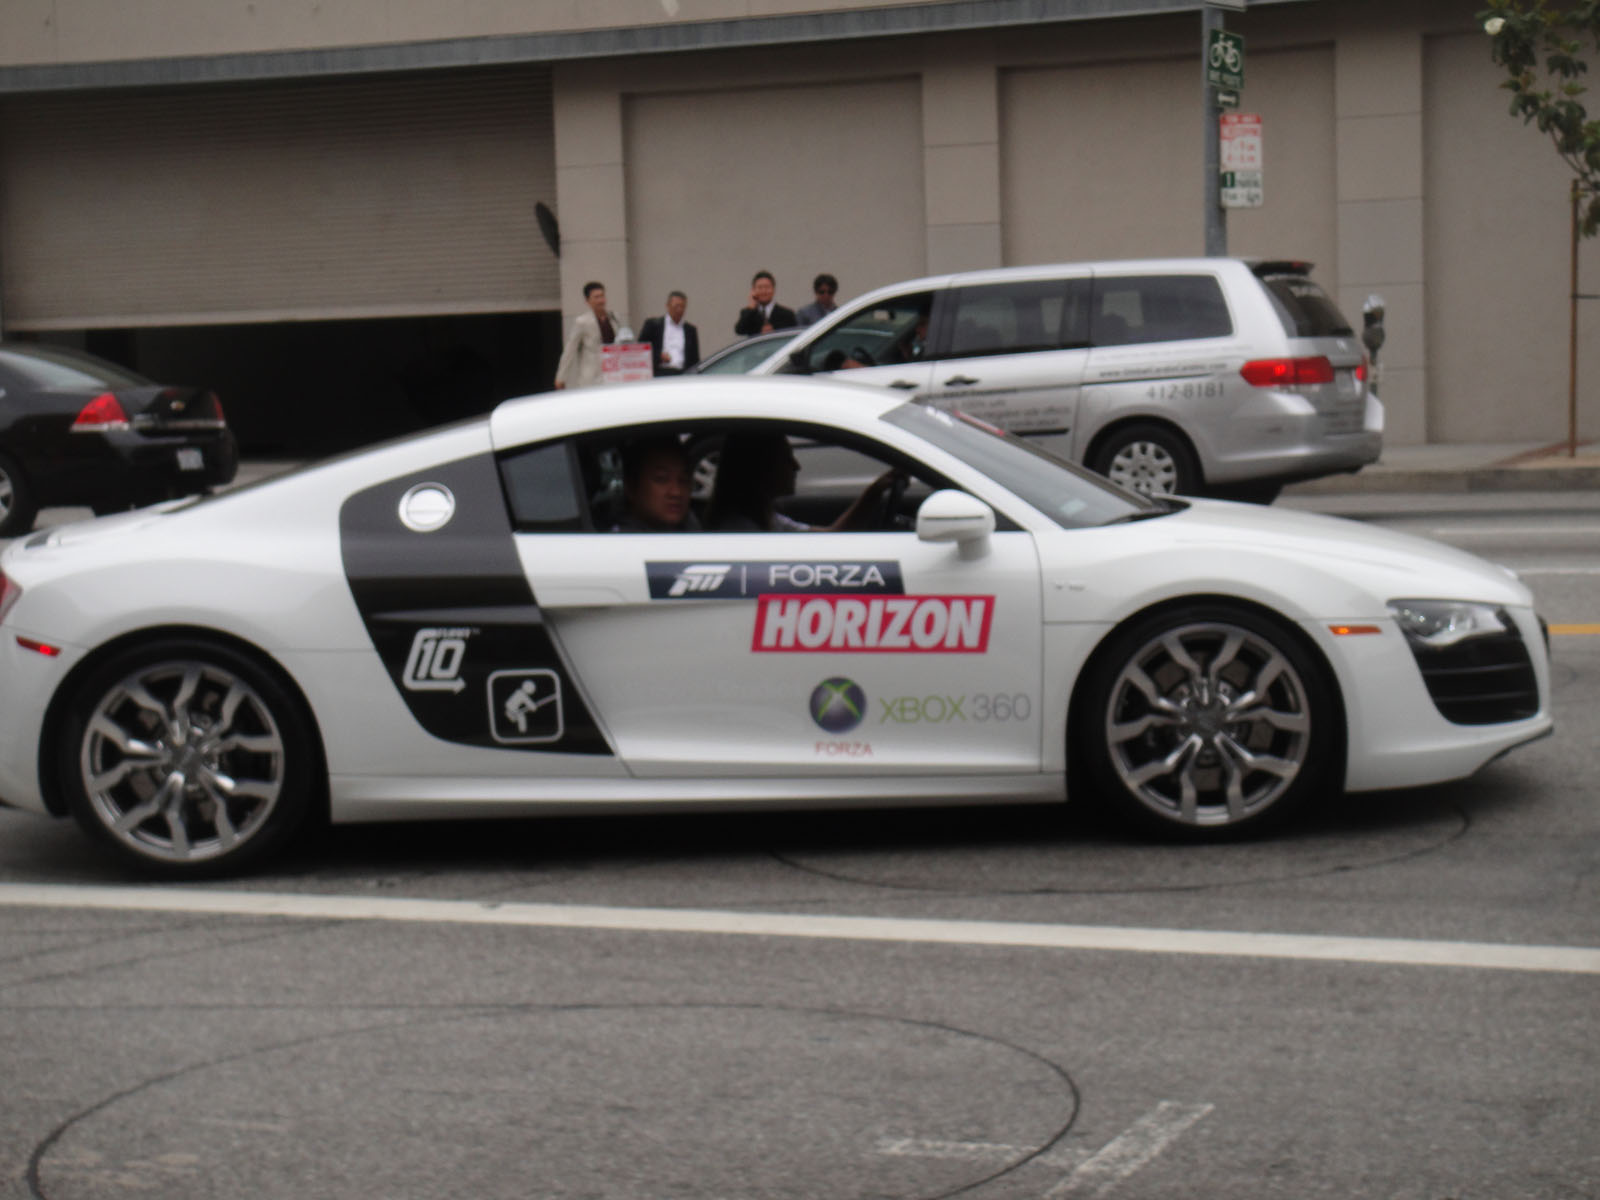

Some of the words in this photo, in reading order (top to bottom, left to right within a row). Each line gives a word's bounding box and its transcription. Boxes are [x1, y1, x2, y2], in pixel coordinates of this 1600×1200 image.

[1146, 382, 1224, 399] 412-8181
[769, 564, 885, 586] FORZA
[761, 599, 985, 648] HORIZON
[416, 640, 466, 679] 10
[879, 696, 967, 723] XBOX
[973, 693, 1031, 721] 360
[814, 741, 873, 756] FORZA
